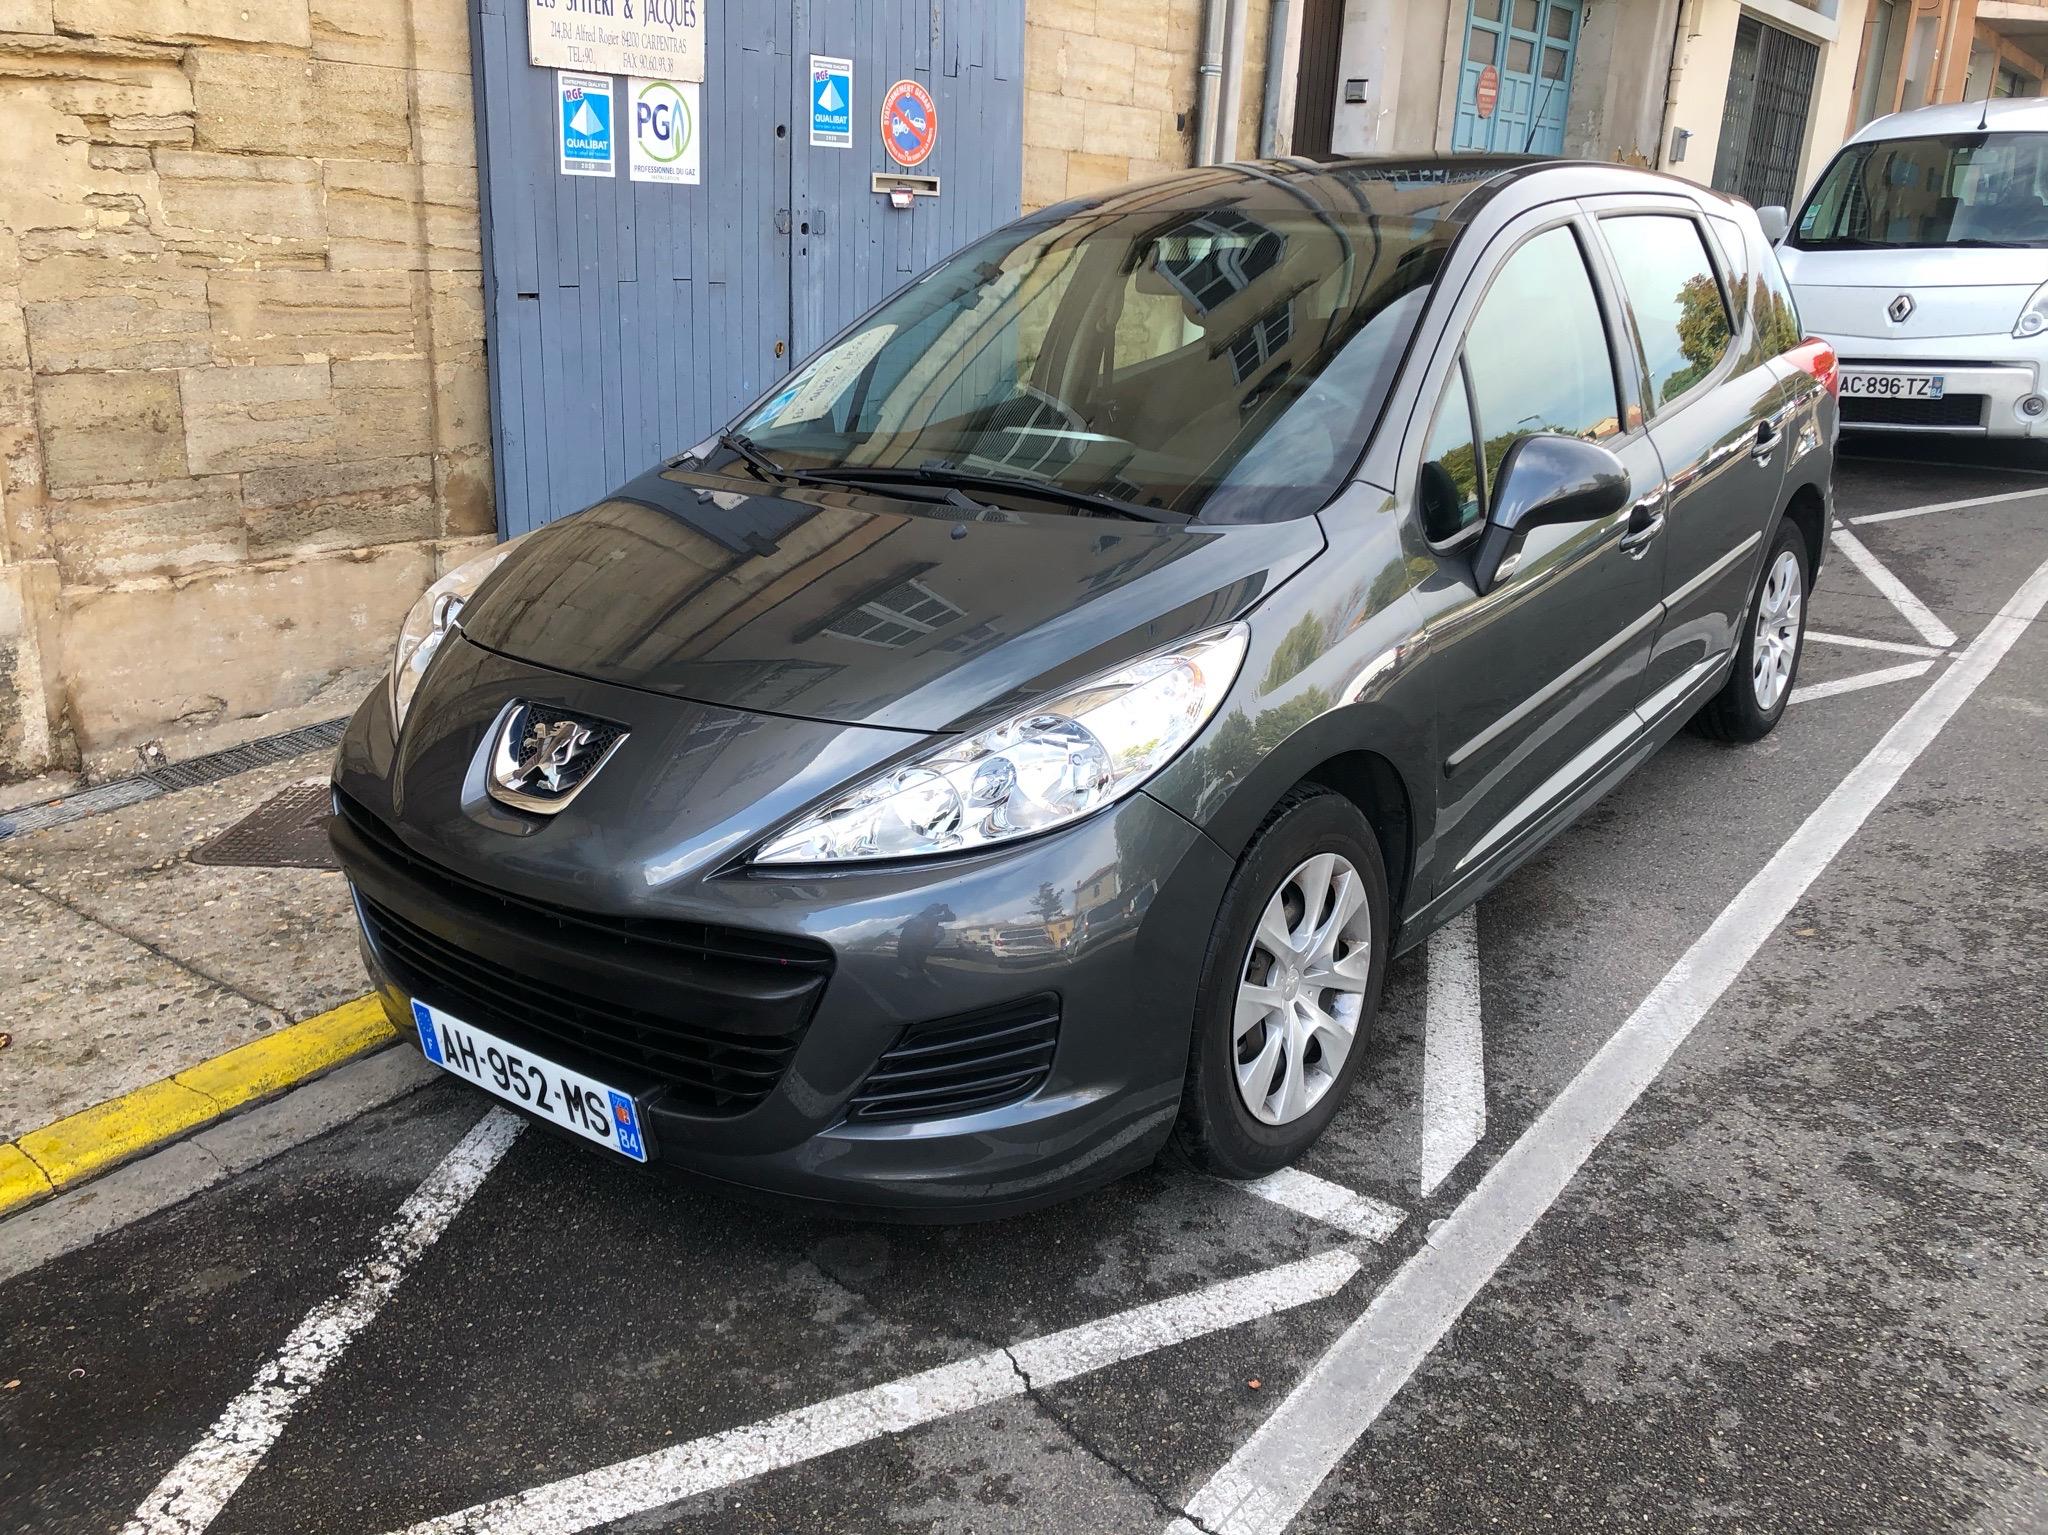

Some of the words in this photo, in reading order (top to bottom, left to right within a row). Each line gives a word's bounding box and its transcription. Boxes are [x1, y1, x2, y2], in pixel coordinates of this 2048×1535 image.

[624, 0, 633, 19] &
[643, 0, 696, 32] JACQUES
[575, 24, 596, 42] Alfred
[621, 31, 639, 48] 84200
[642, 33, 687, 54] CARPENTRAS
[814, 70, 829, 81] RGE
[565, 88, 583, 101] RGE
[883, 83, 915, 126] STATIONNEMENT
[814, 114, 848, 124] QUALIBAT
[566, 138, 609, 150] QUALIBAT
[633, 164, 675, 175] PROFESSIONNEL
[676, 167, 684, 175] DU
[685, 168, 696, 176] GAZ
[1839, 376, 1931, 396] AC-896-TZ
[441, 1023, 611, 1138] AH-952-MS
[619, 1127, 639, 1153] 84
